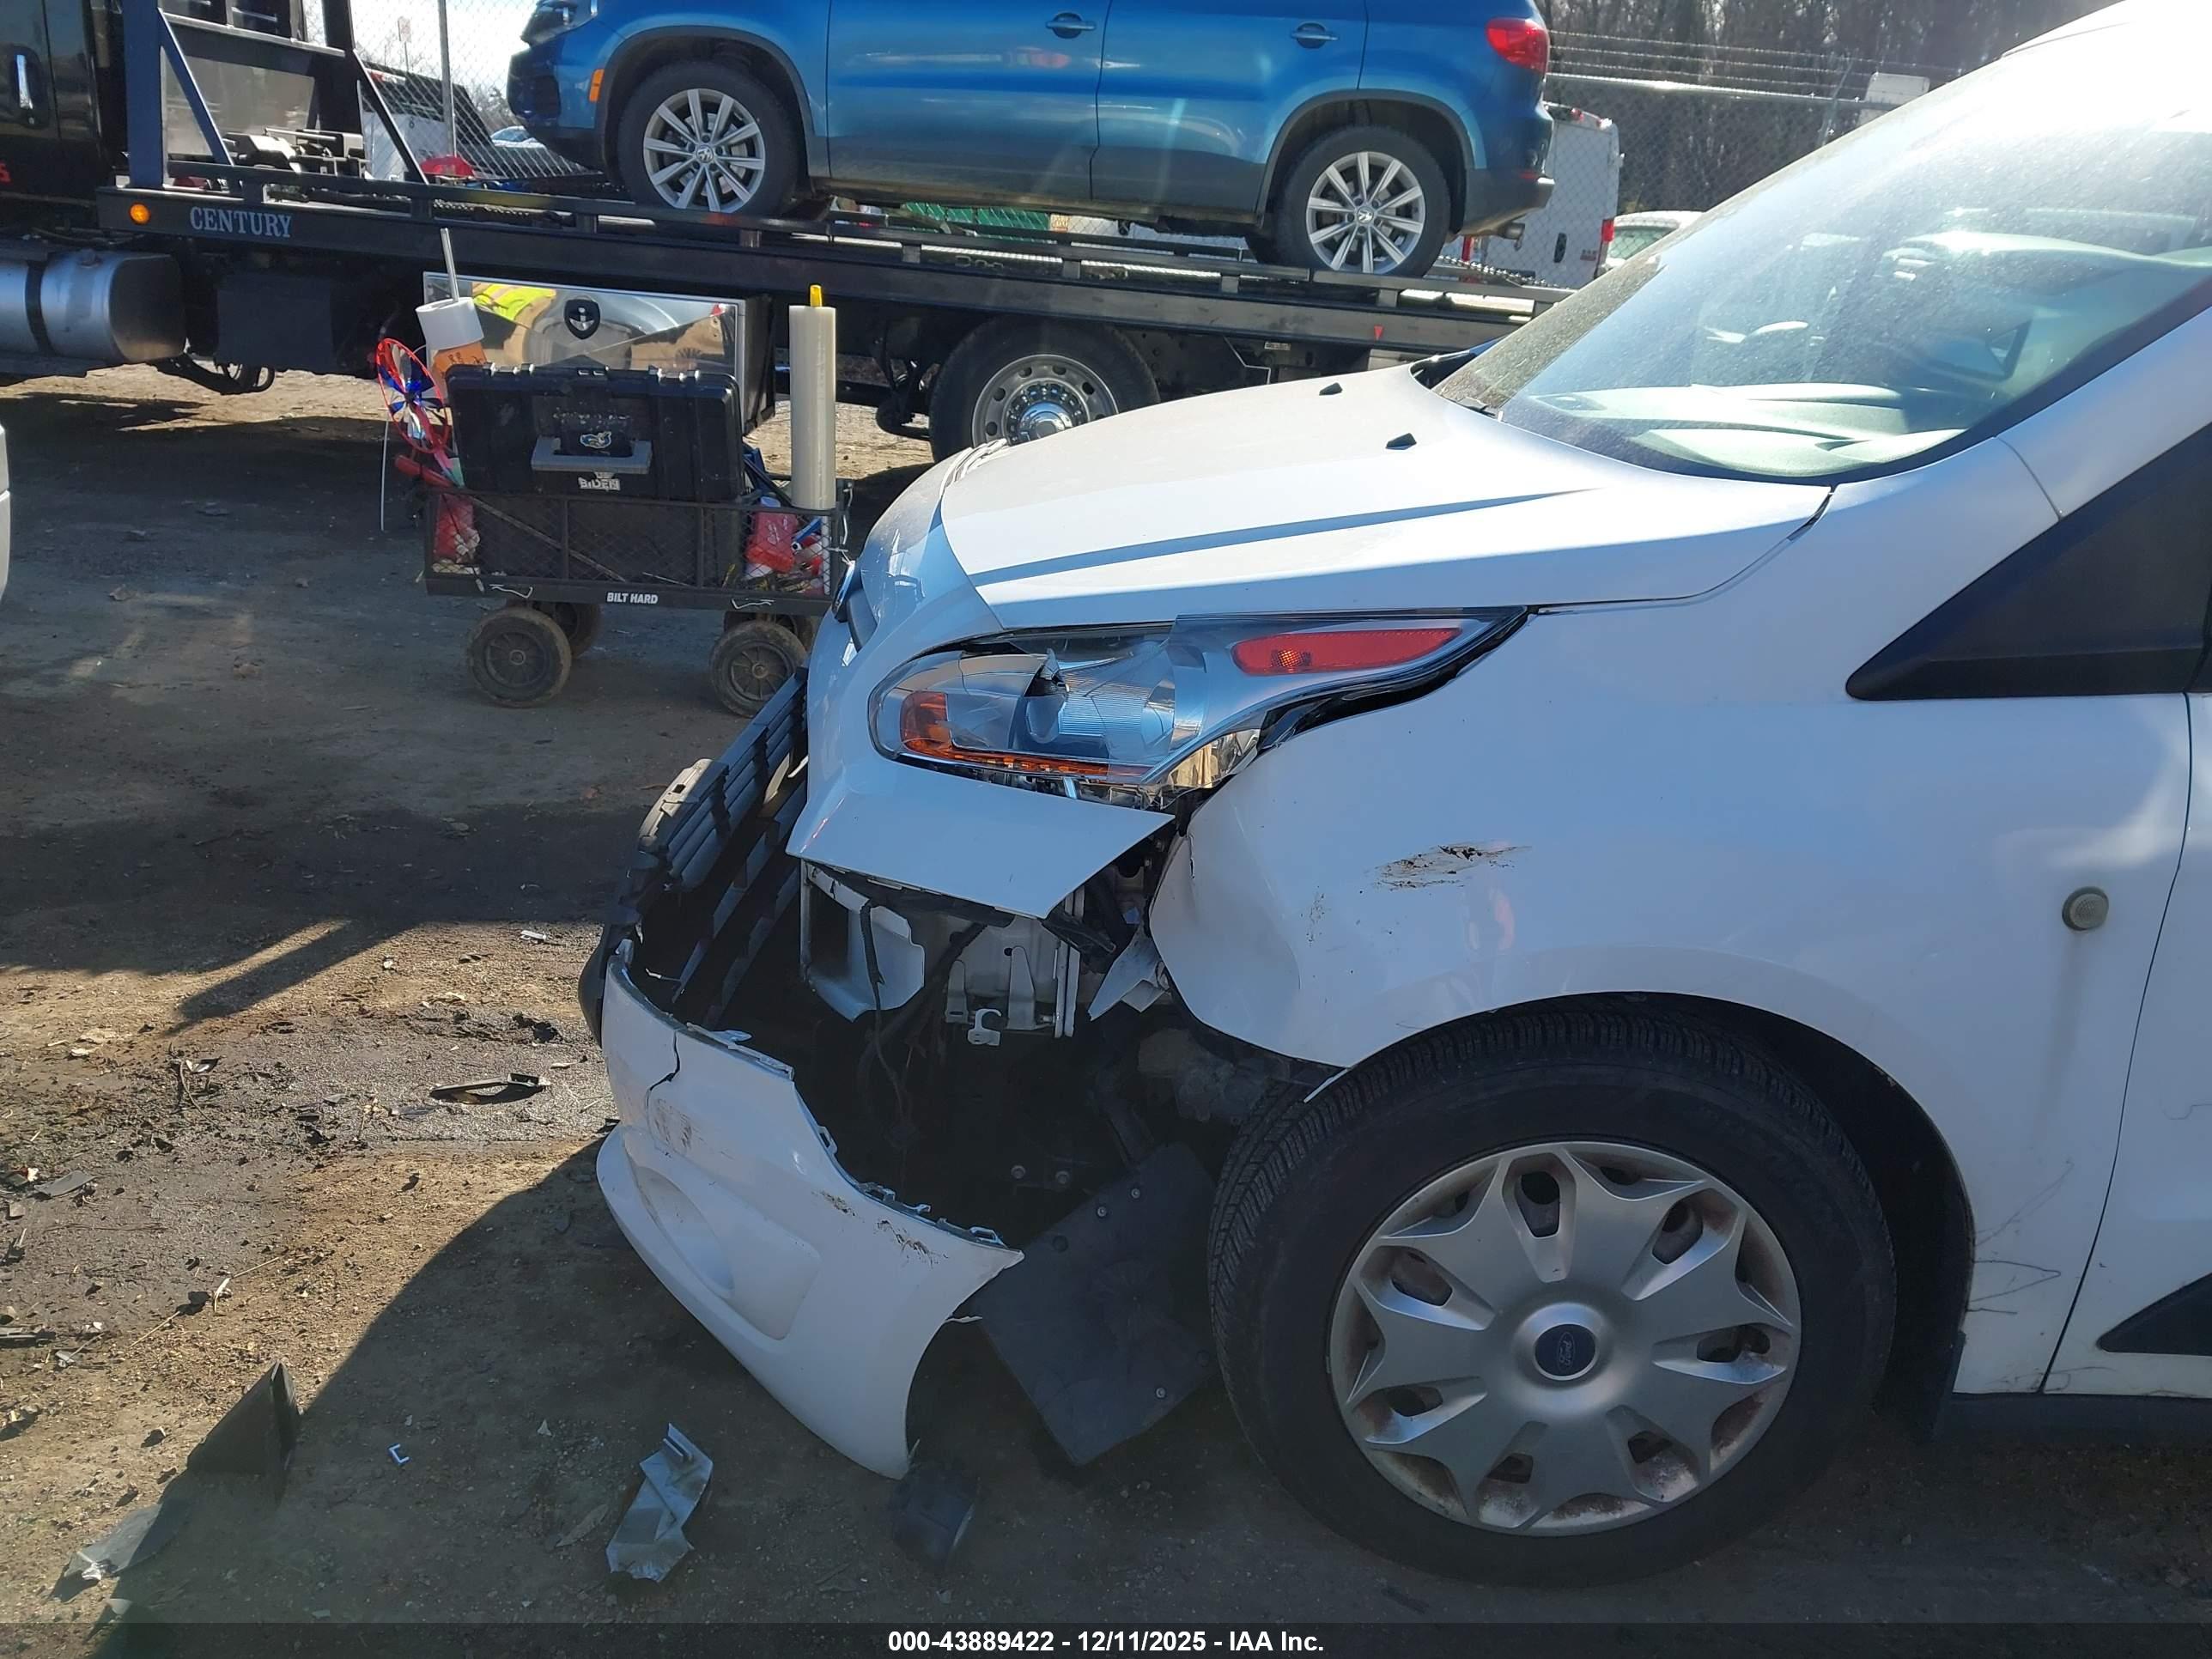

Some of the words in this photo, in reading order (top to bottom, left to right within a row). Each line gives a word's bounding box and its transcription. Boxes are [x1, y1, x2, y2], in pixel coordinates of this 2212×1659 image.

[190, 206, 291, 238] CENTURY
[578, 477, 621, 491] BIDEN
[606, 592, 629, 603] BILT
[629, 592, 659, 605] HARD
